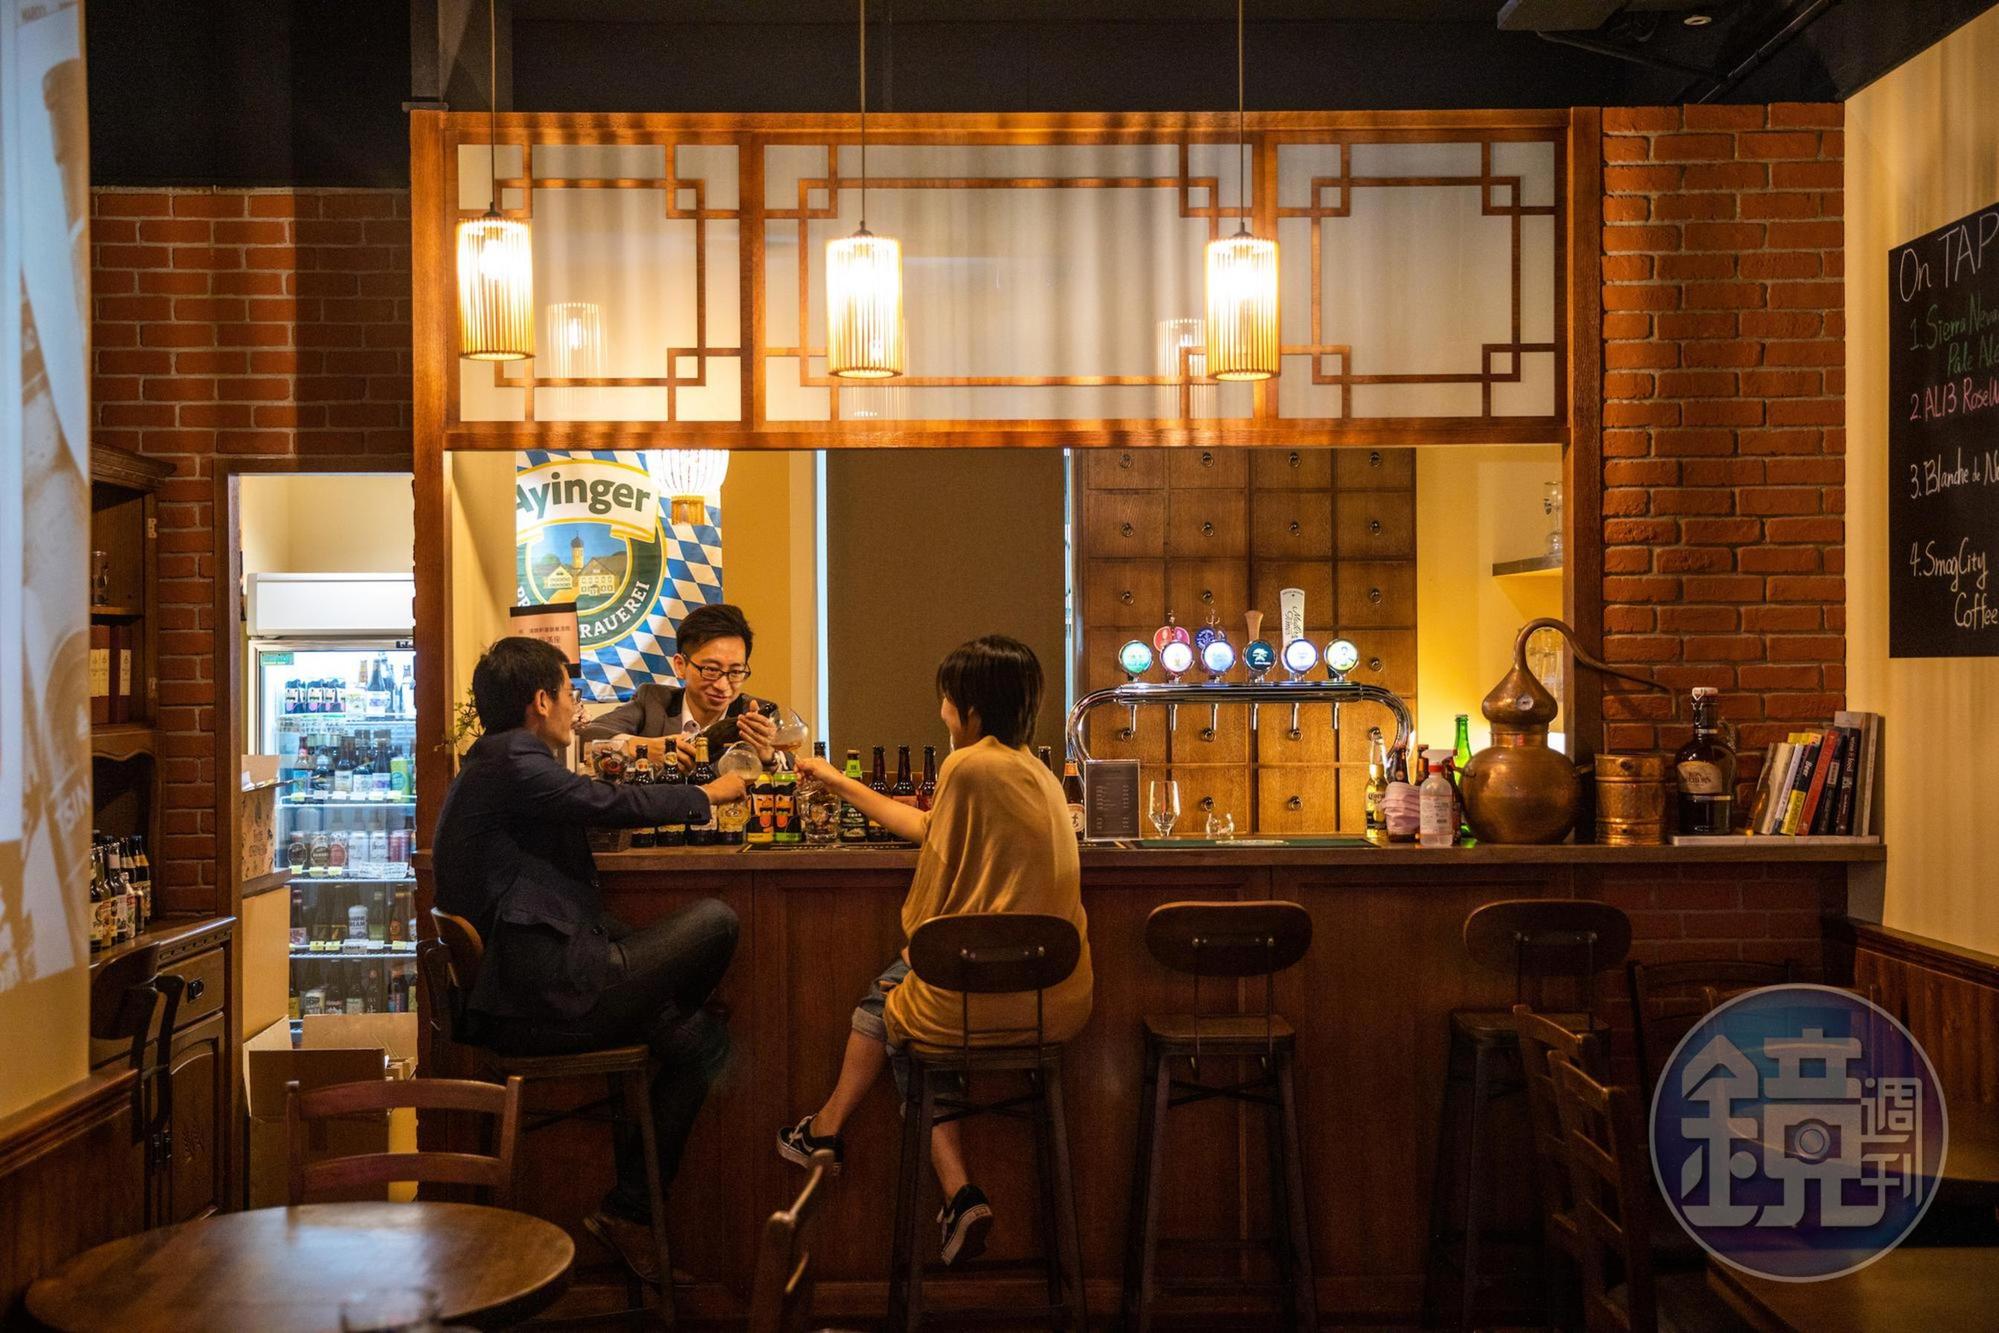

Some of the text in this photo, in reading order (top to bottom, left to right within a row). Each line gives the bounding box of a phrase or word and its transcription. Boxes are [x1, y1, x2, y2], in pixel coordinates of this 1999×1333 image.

[1900, 212, 1999, 302] On TAP
[516, 471, 651, 520] Ayinger
[1923, 447, 1968, 496] Blanche
[579, 580, 650, 639] RAUEREI
[1954, 592, 1998, 630] Coffee
